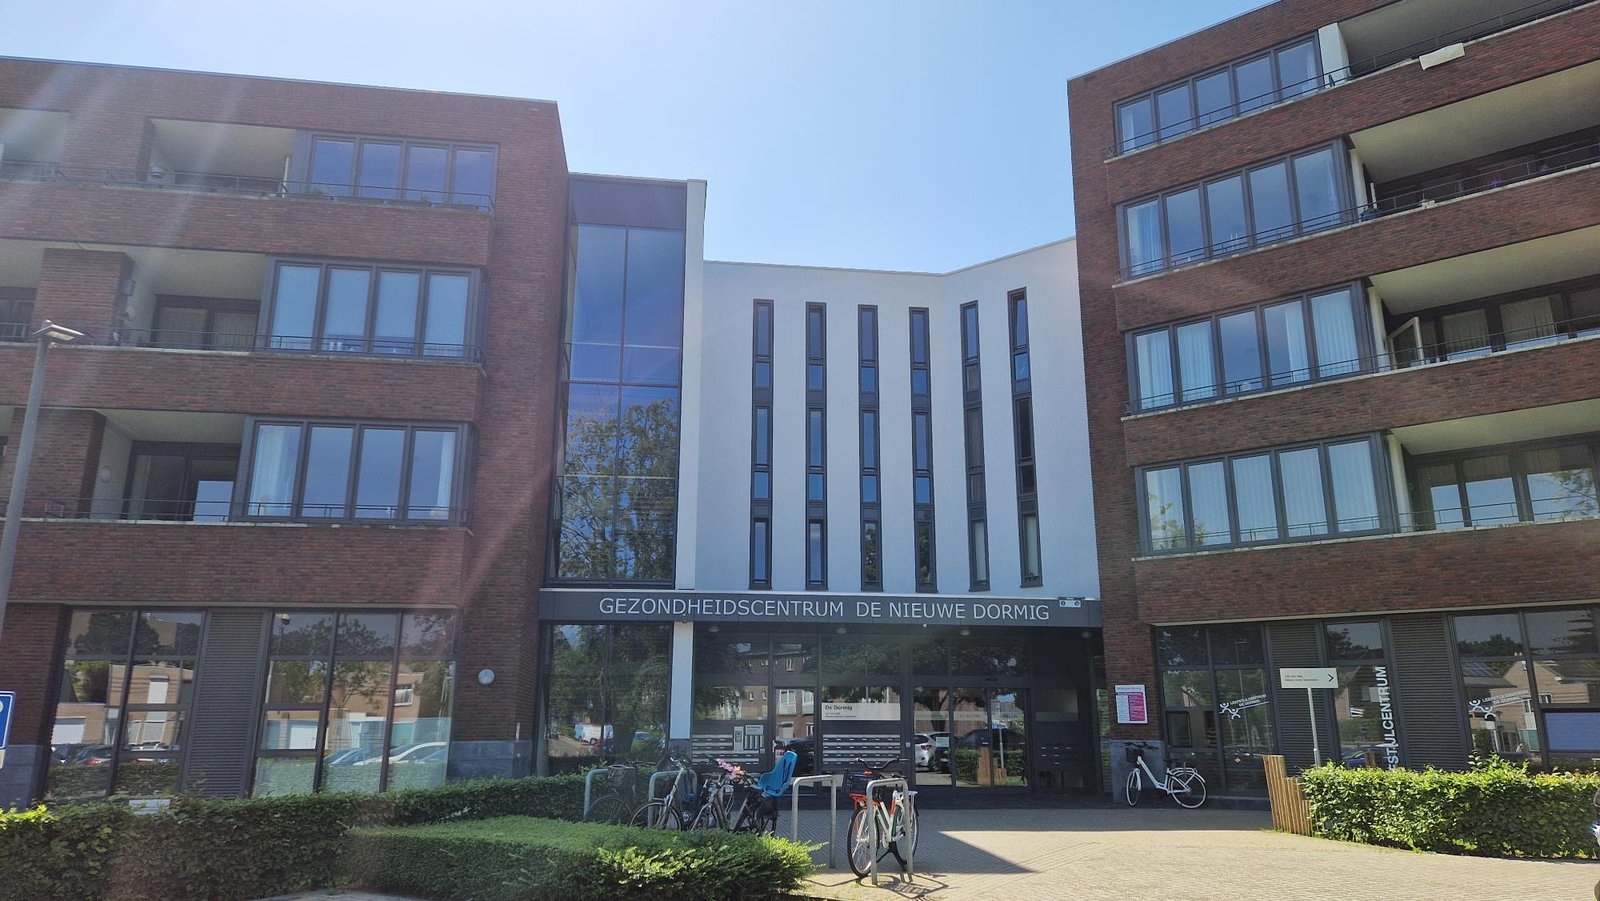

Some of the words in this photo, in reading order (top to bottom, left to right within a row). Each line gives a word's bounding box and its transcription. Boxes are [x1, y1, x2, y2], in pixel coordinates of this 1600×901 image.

[598, 597, 845, 618] GEZONDHEIDSCENTRUM
[856, 602, 881, 618] DE
[889, 602, 966, 619] NIEUWE
[973, 604, 1049, 620] DORMIG
